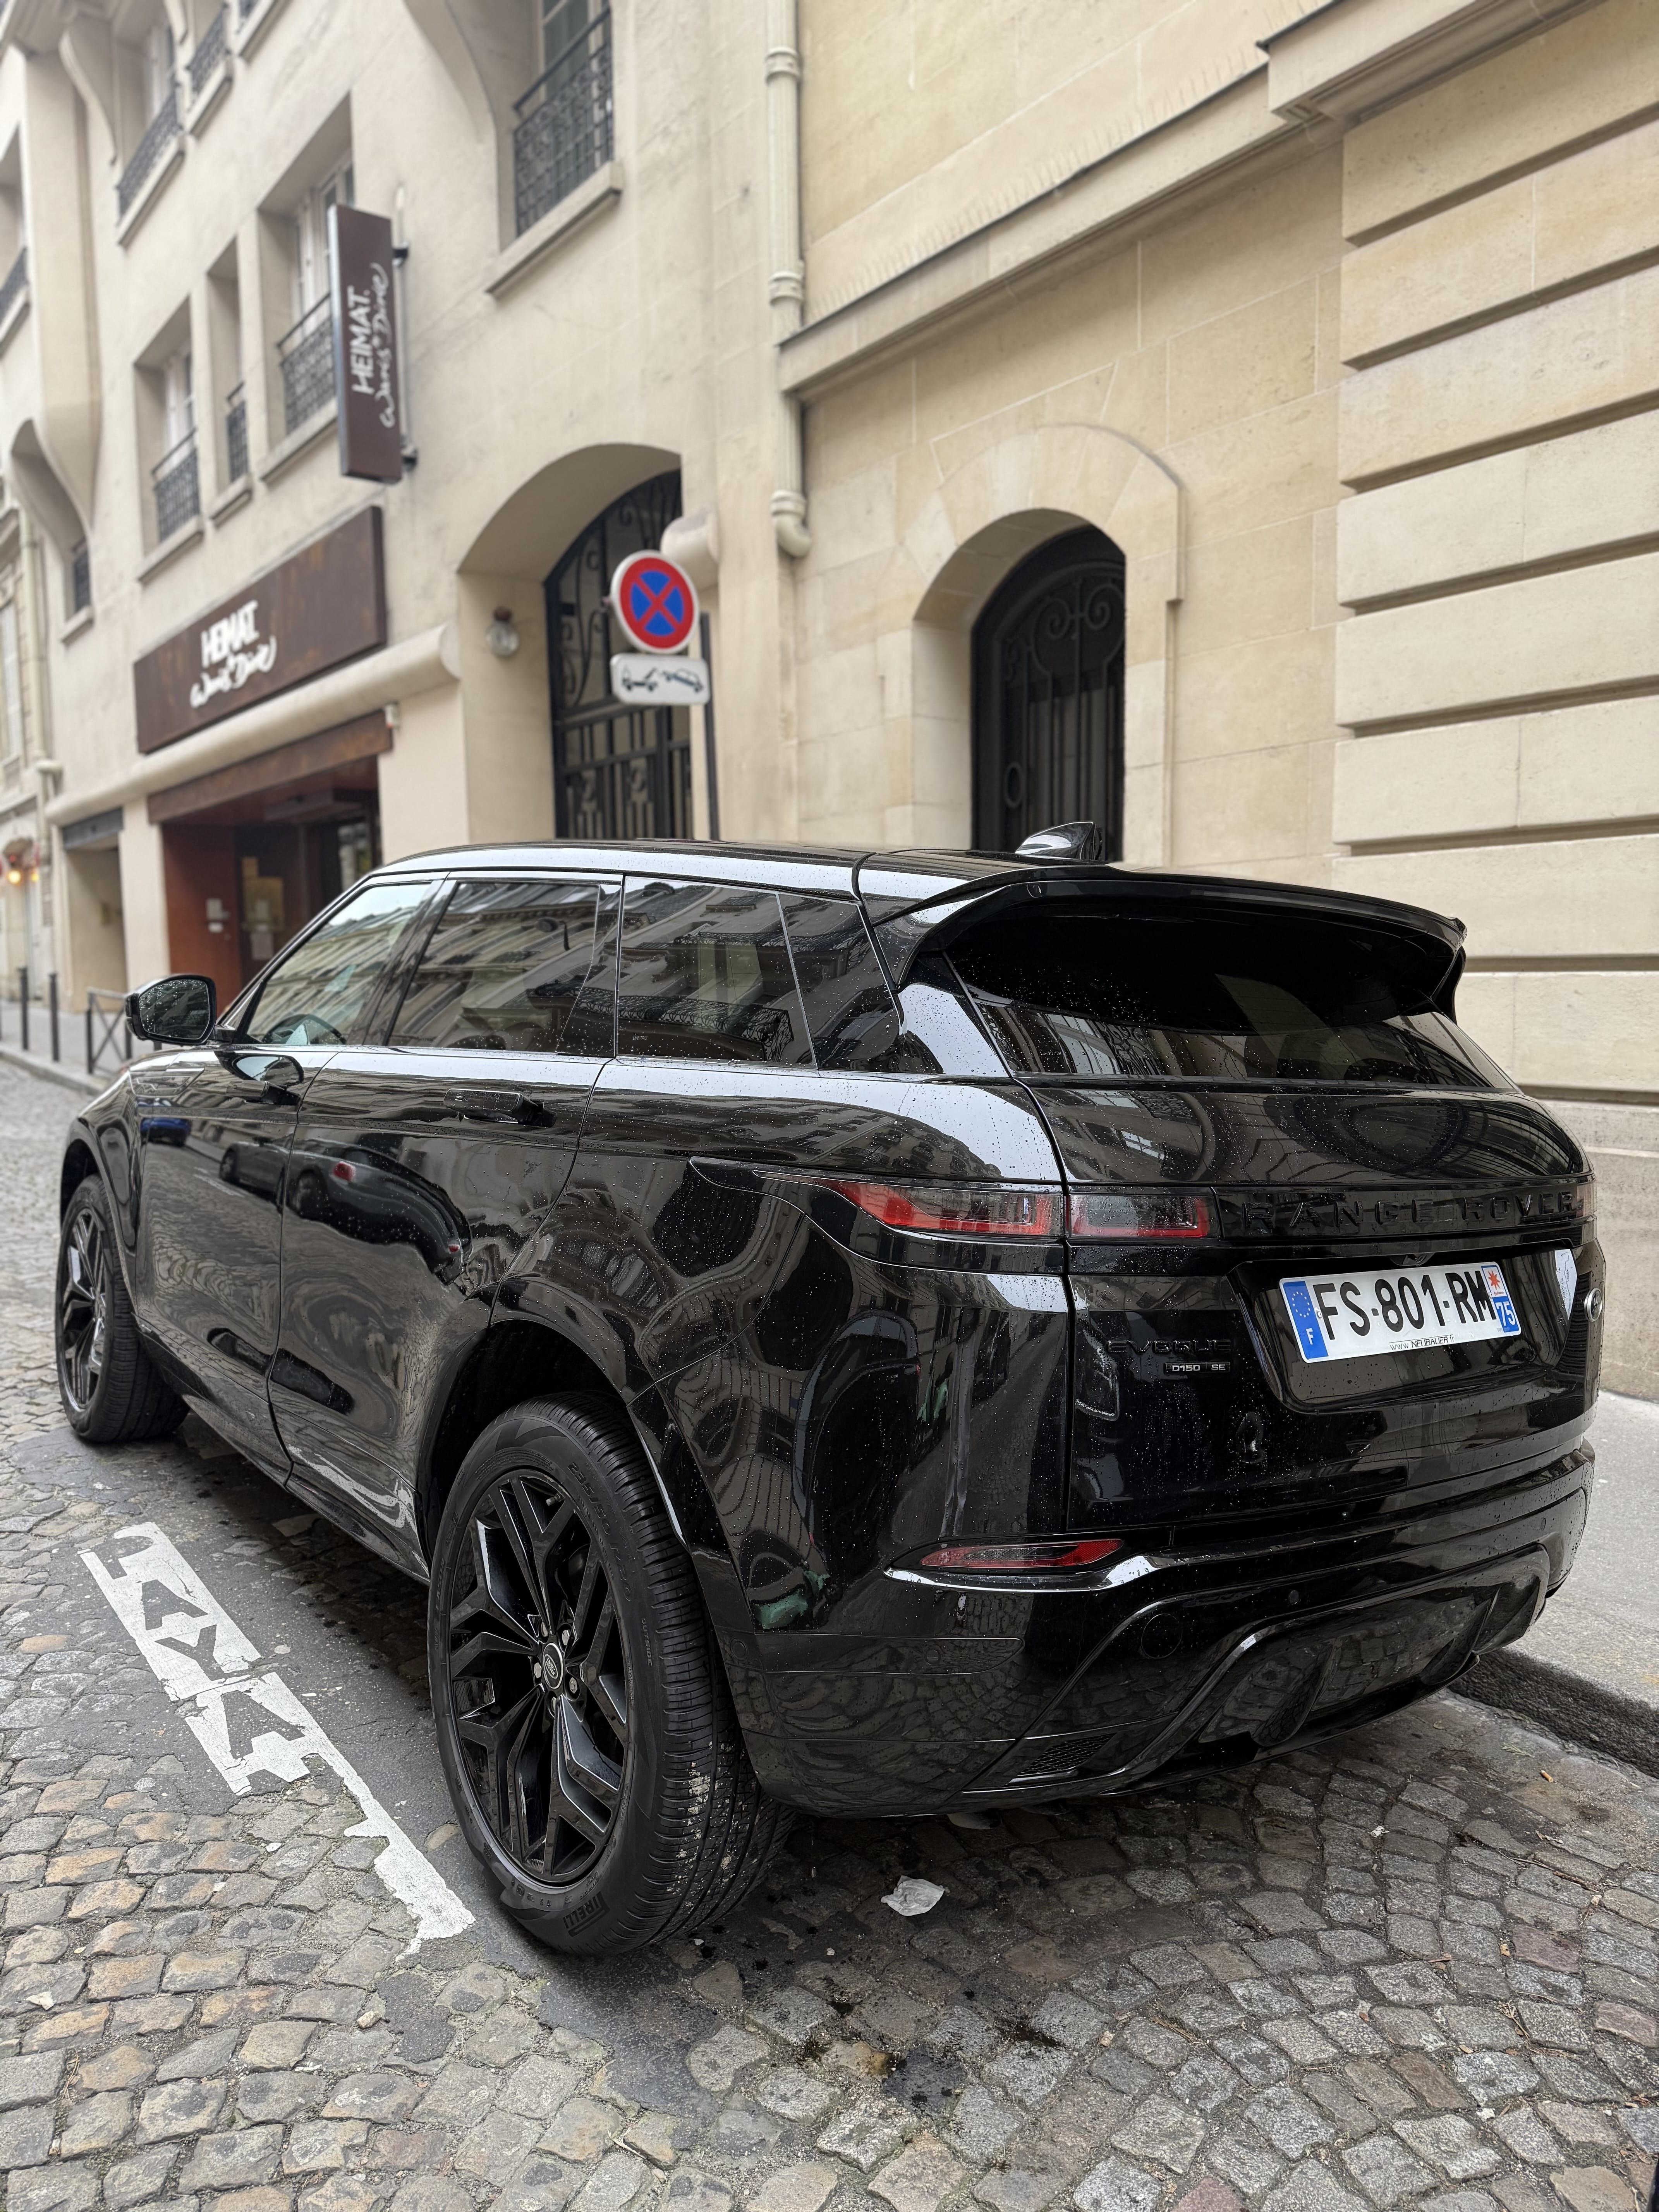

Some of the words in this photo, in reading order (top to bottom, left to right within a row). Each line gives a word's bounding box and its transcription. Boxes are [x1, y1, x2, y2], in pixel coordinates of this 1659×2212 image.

[1242, 1198, 1434, 1229] RANGE
[1462, 1191, 1573, 1222] ROVER
[1312, 1270, 1497, 1340] FS-801-RM
[1496, 1301, 1516, 1326] 75
[1106, 1339, 1231, 1354] EVOQUE
[1305, 1328, 1314, 1345] F
[567, 1461, 612, 1536] 235/50
